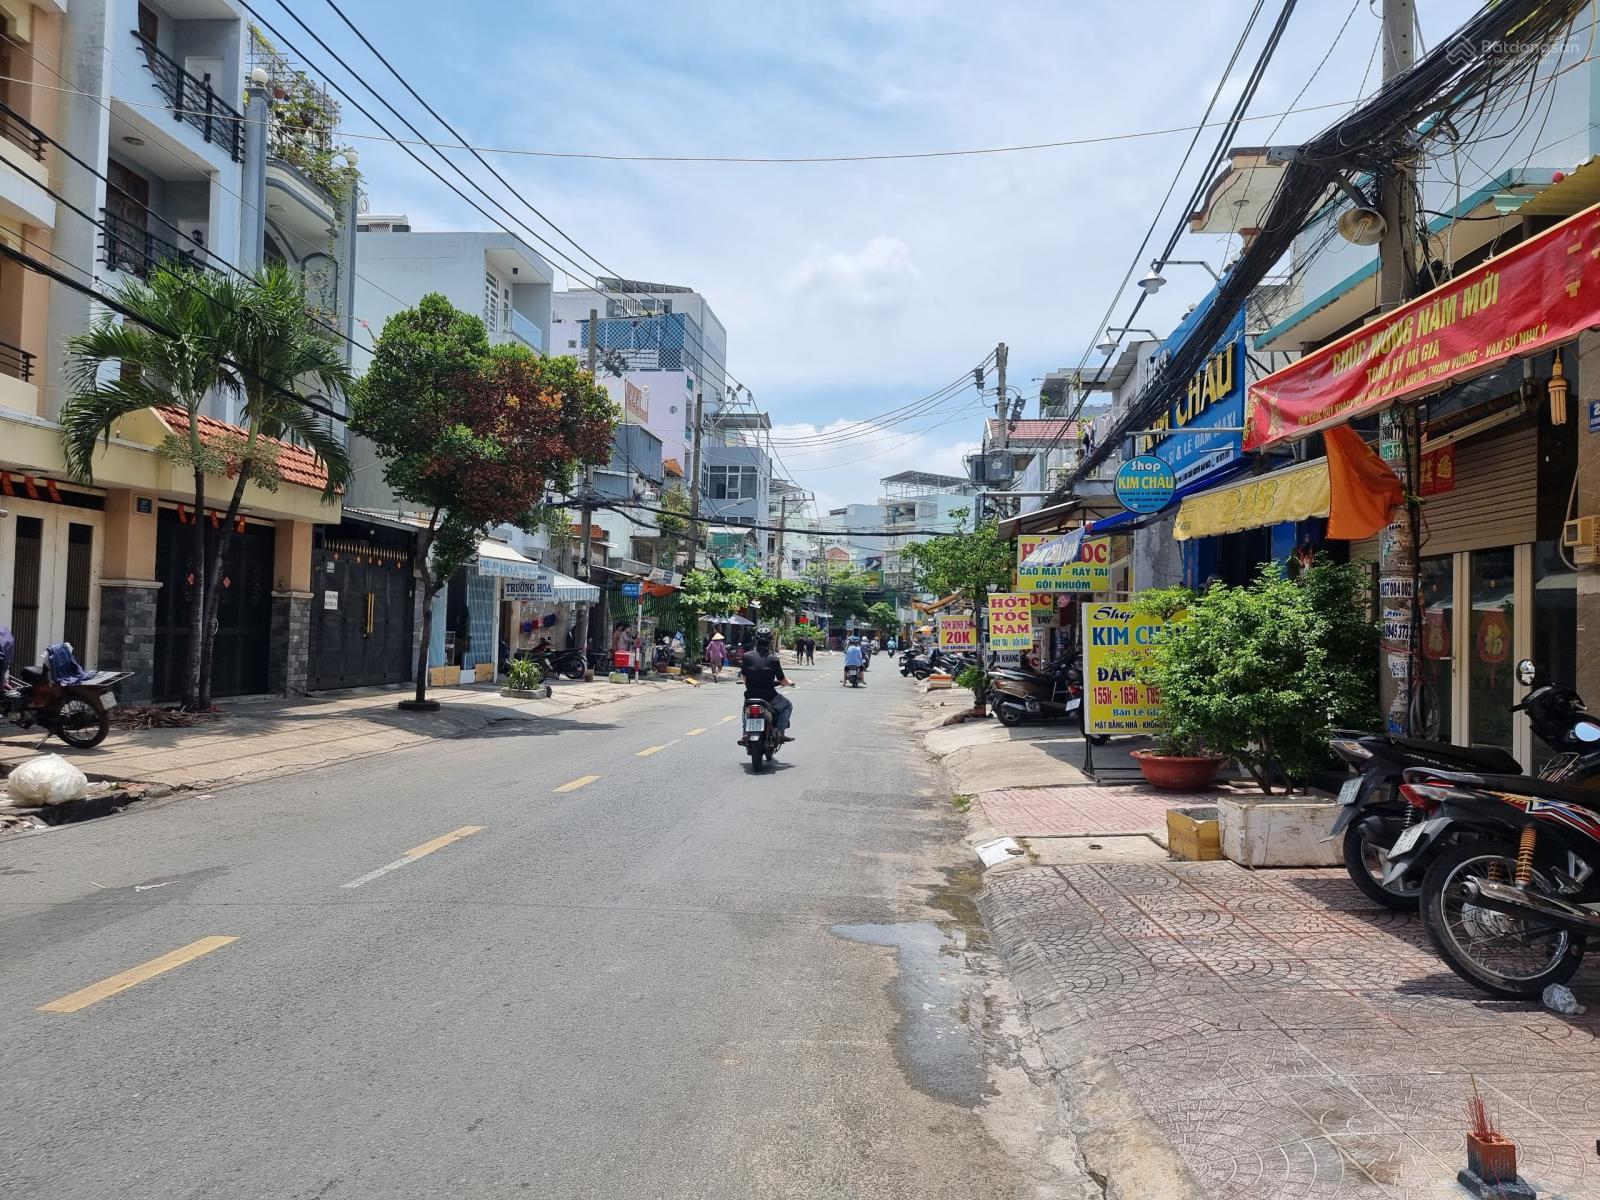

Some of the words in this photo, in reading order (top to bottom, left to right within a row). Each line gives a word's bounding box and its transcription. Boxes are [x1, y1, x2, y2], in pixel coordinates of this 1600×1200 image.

[1331, 339, 1367, 378] CHÚC
[1367, 312, 1414, 360] MỪNG
[1417, 293, 1458, 339] NĂM
[1462, 270, 1500, 319] MỚI
[1421, 339, 1440, 362] GIA
[1130, 460, 1161, 473] Shop
[1118, 476, 1139, 489] KIM
[1141, 472, 1174, 489] CHÂU
[1094, 568, 1109, 576] TAI
[537, 584, 552, 593] HOA
[991, 596, 1029, 608] HỚT
[992, 609, 1029, 621] TÓC
[1093, 606, 1135, 623] Shop
[992, 624, 1029, 634] NAM
[1092, 626, 1129, 645] KIM
[946, 631, 970, 643] 20K
[1093, 686, 1112, 705] 155k
[1120, 686, 1138, 705] 165k
